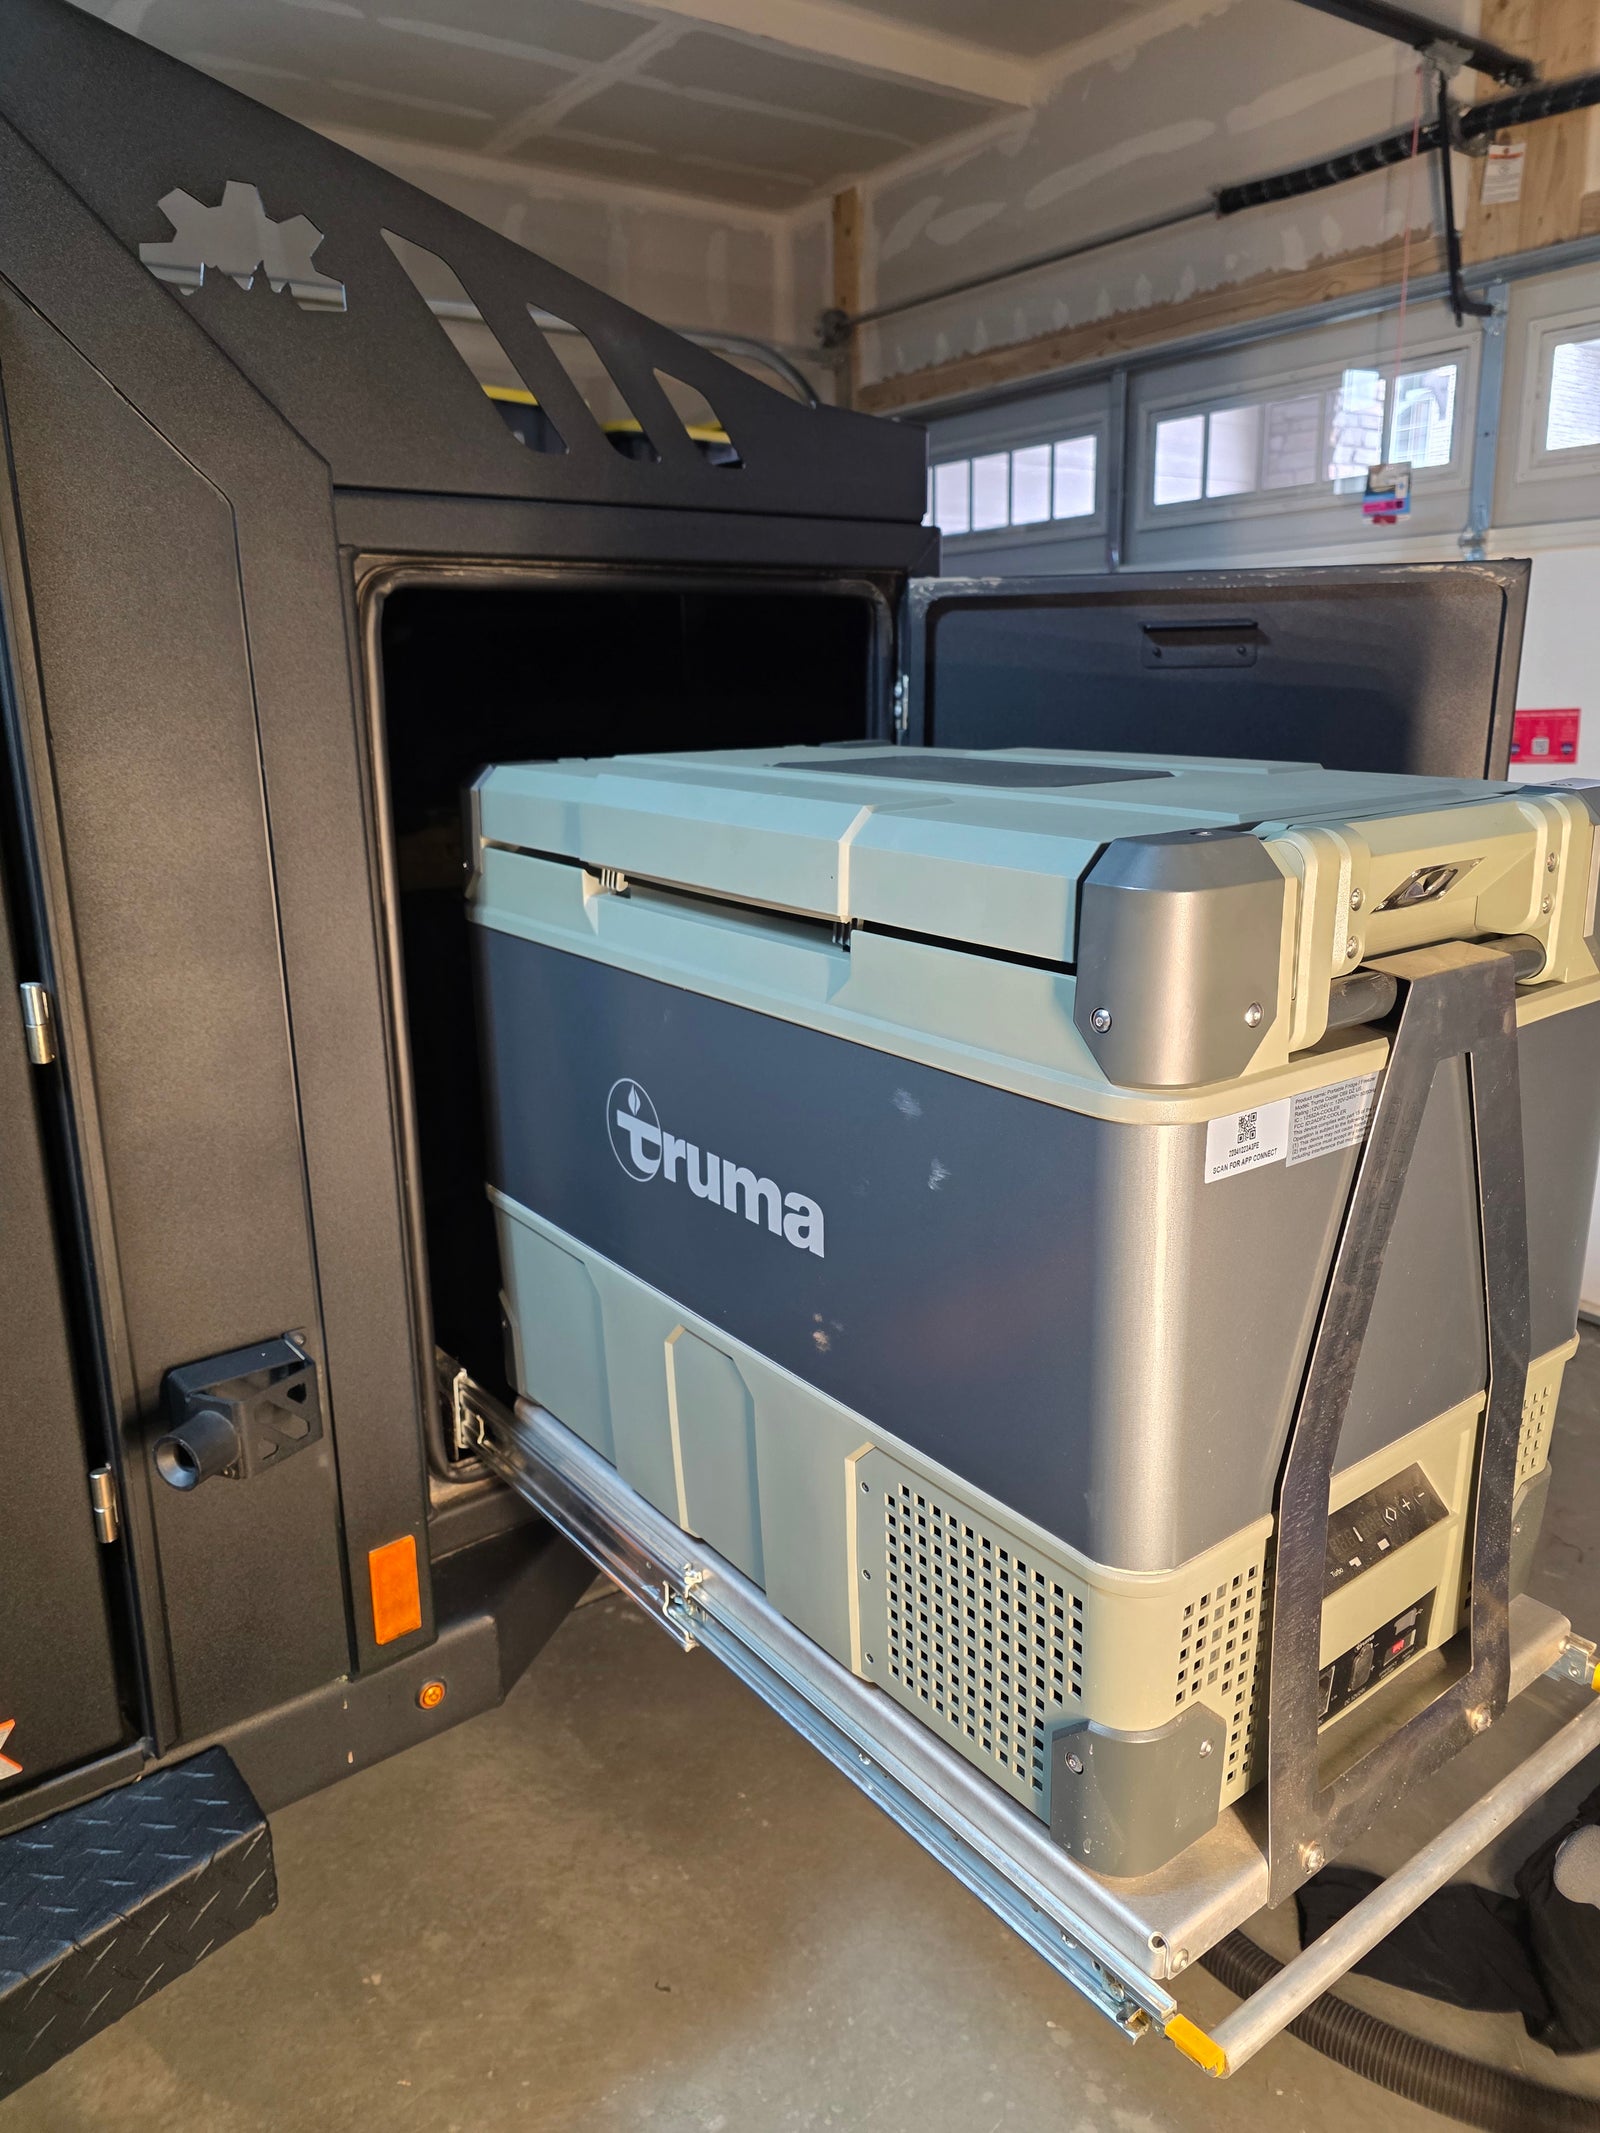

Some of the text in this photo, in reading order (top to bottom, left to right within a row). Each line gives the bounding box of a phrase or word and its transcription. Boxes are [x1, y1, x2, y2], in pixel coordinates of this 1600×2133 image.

[1295, 1095, 1312, 1105] Product
[1327, 1086, 1344, 1095] Portable
[1311, 1098, 1324, 1106] Truma
[1325, 1094, 1339, 1102] Cooler
[1293, 1132, 1314, 1142] Operation
[1312, 1143, 1336, 1154] interference
[1212, 1148, 1278, 1175] SCAN FOR APP CONNECT
[617, 1108, 825, 1259] truma
[1329, 1567, 1344, 1577] Turbo
